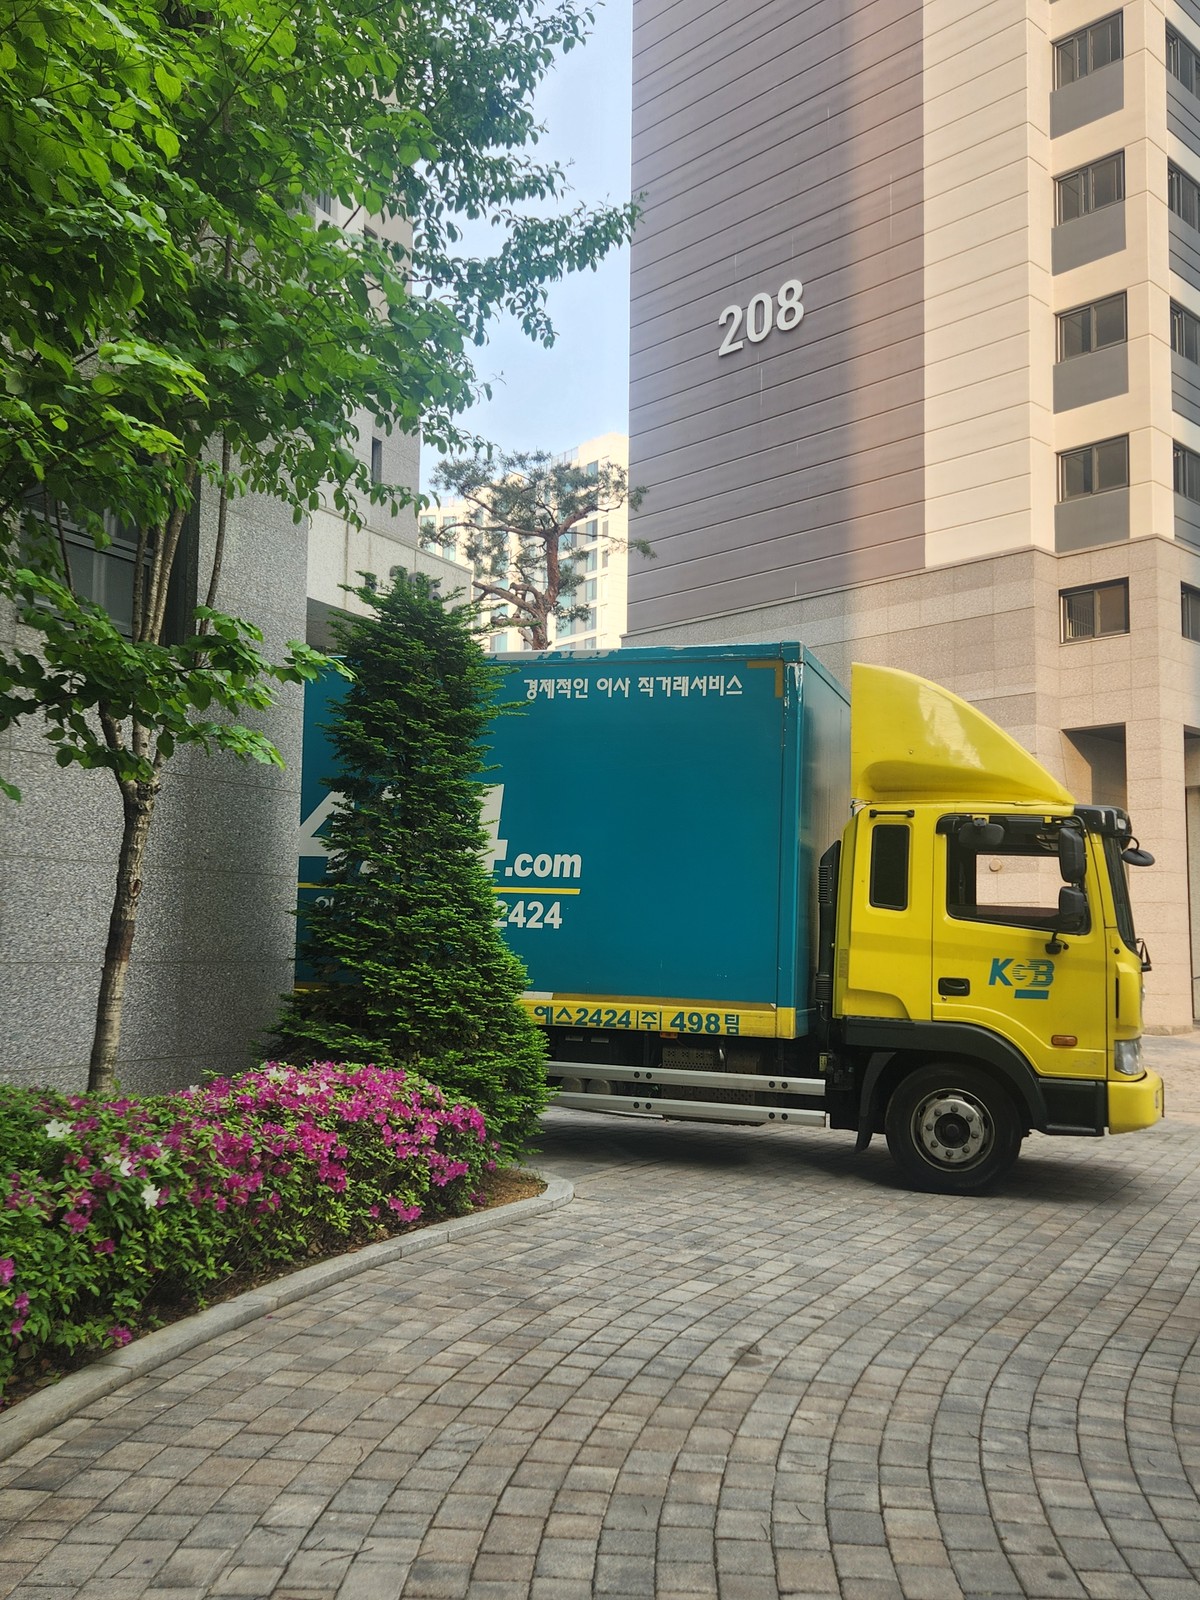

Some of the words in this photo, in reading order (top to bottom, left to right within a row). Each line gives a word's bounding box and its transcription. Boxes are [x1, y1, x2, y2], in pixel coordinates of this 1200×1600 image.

[718, 279, 804, 356] 208
[523, 678, 589, 700] 경제적인
[596, 677, 631, 698] 이사
[637, 674, 743, 698] 직거래서비스
